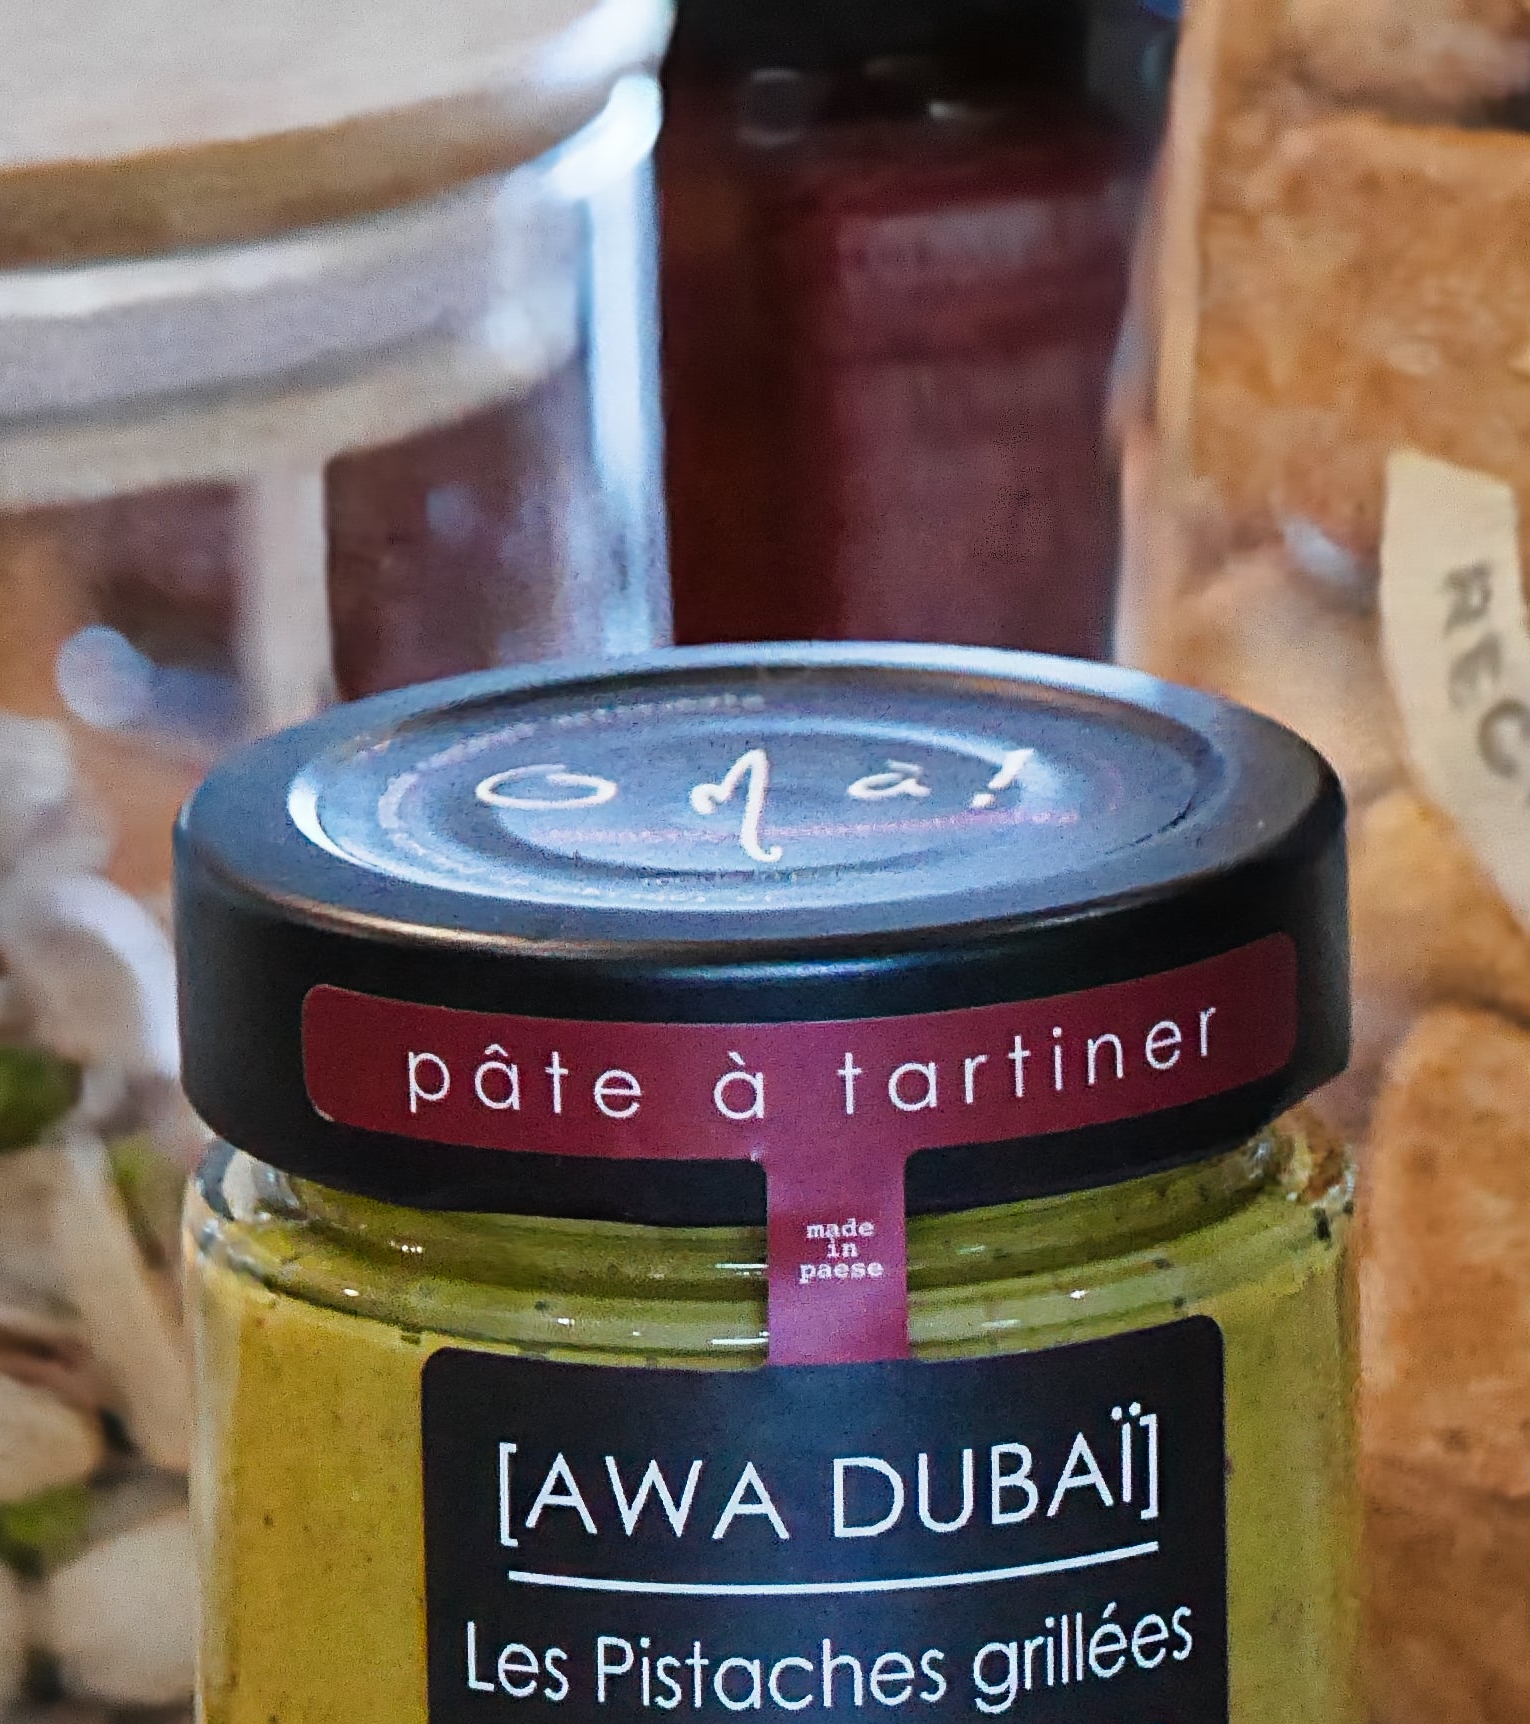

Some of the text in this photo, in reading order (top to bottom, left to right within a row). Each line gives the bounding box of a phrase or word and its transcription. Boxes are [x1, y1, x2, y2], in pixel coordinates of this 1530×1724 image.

[409, 1007, 1216, 1121] pâte à tartiner
[806, 1217, 876, 1239] made
[826, 1238, 859, 1258] in
[799, 1261, 885, 1285] paese
[467, 1601, 1193, 1715] Les Pistaches grillées
